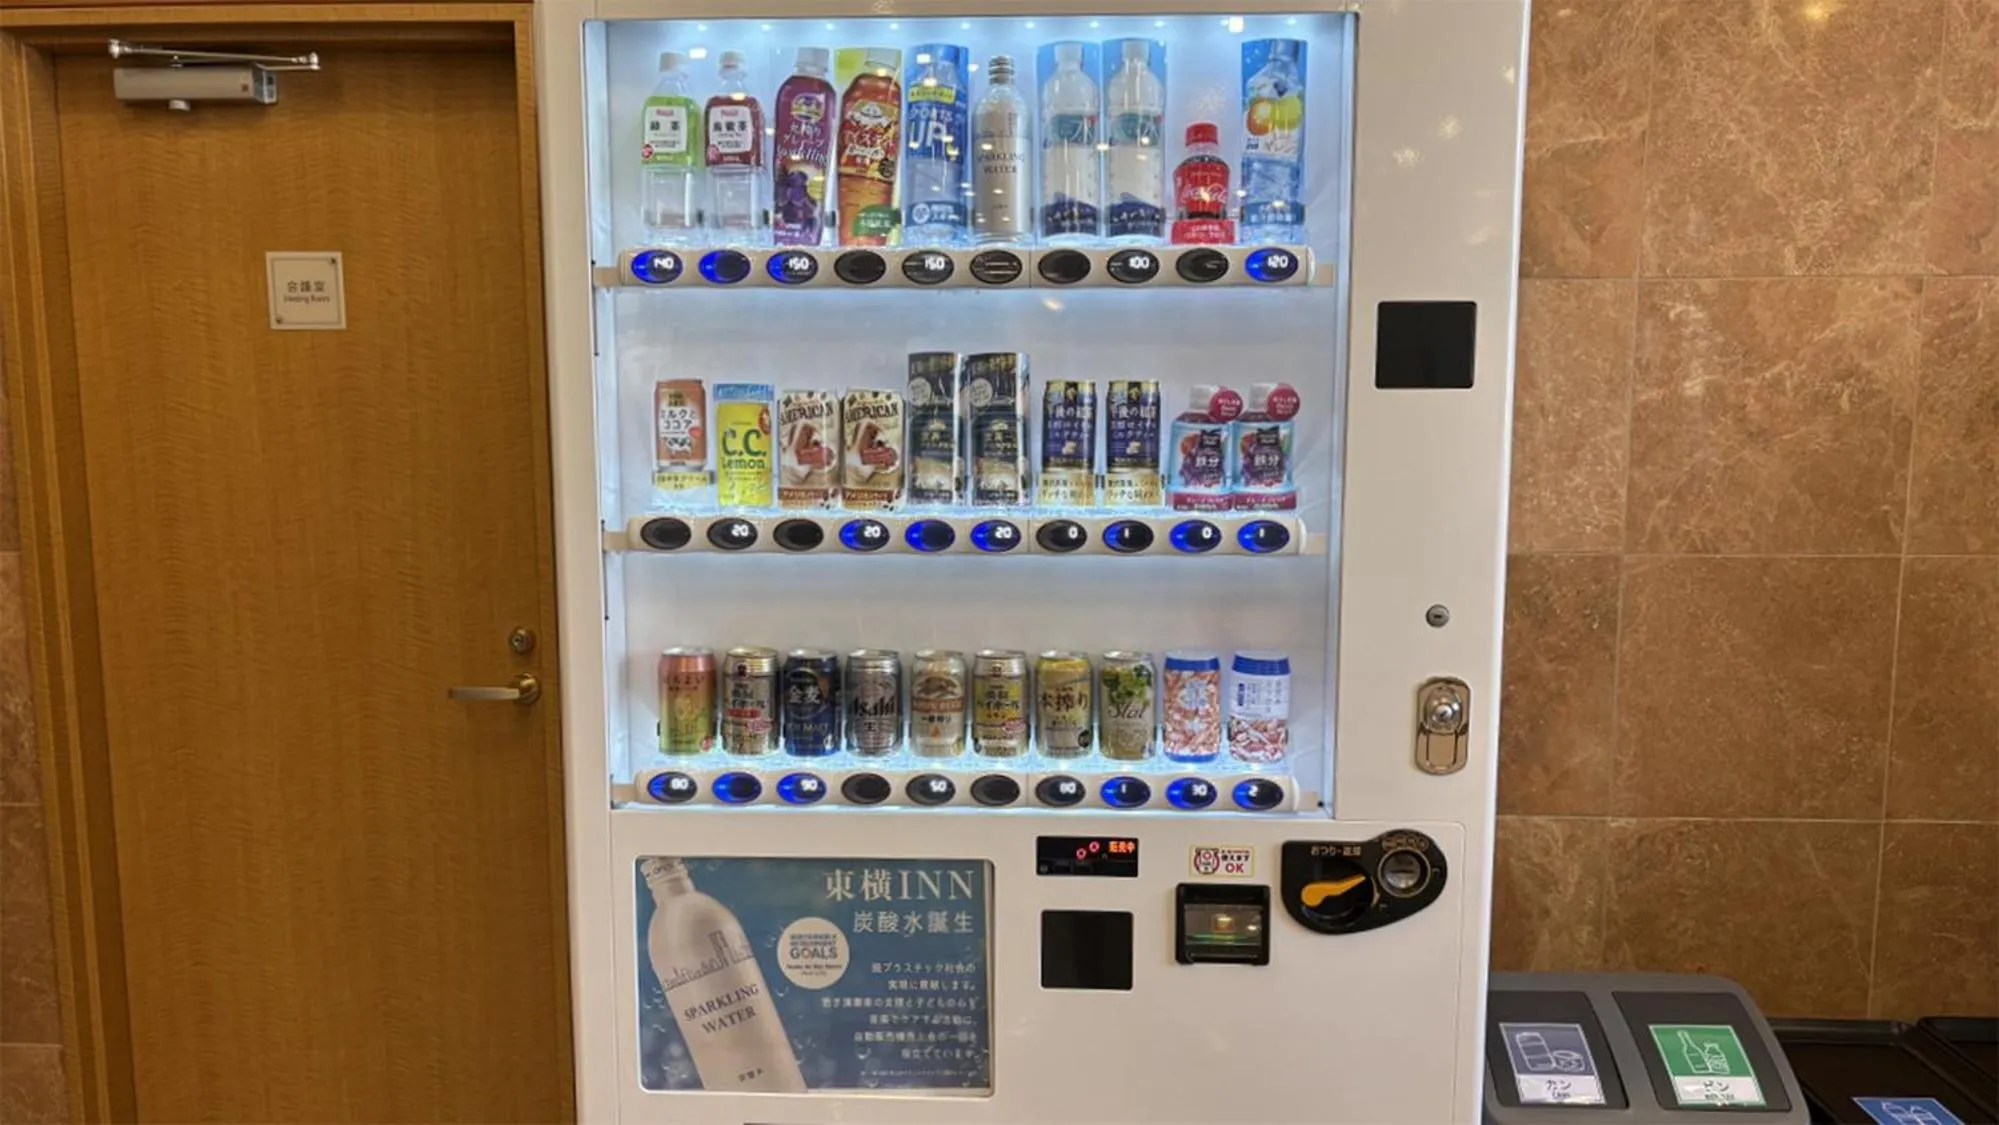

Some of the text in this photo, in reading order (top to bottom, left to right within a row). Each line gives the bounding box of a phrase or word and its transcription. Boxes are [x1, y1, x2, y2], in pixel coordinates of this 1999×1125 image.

[664, 420, 692, 430] ココア
[722, 428, 767, 457] C.C.
[853, 697, 895, 717] Asahi
[1225, 863, 1244, 873] OK
[825, 869, 975, 902] 東横INN
[853, 911, 974, 934] 炭酸水誕生
[790, 947, 838, 960] GOALS
[685, 983, 760, 1022] SPARKLING
[701, 1006, 756, 1034] WATER
